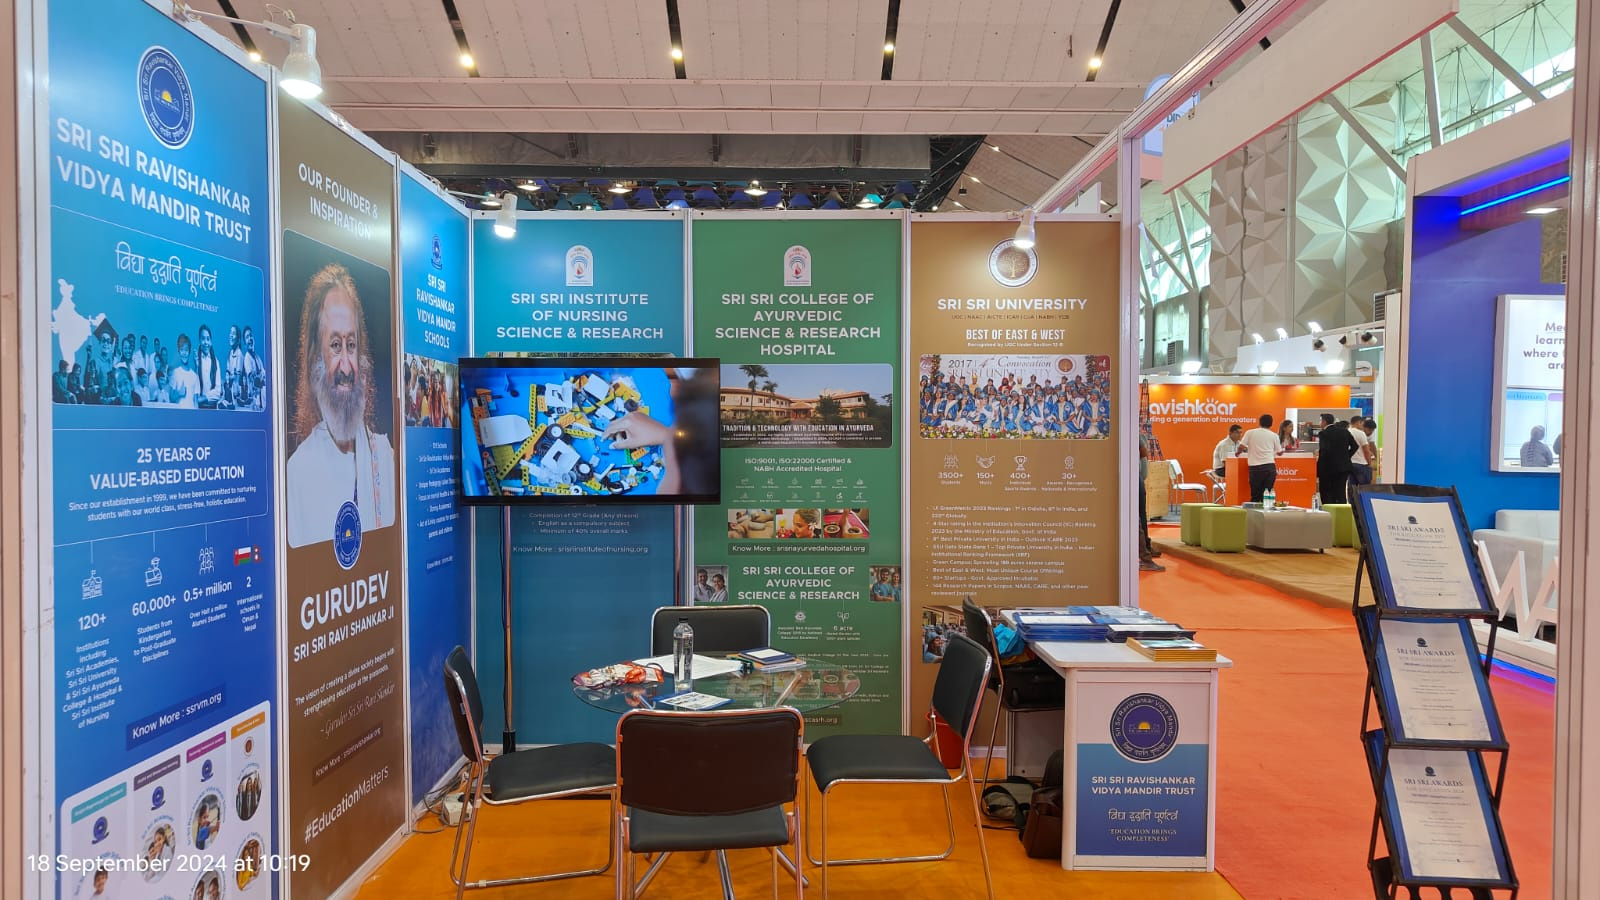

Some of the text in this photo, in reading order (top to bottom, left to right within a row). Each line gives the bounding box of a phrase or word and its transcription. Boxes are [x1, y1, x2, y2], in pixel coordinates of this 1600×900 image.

[57, 117, 250, 215] SRI SRI RAVISHANKAR
[299, 163, 378, 219] OUR FOUNDER &
[56, 155, 251, 244] VIDYA MANDIR TRUST
[310, 197, 371, 239] INSPIRATION
[428, 274, 446, 292] SRI SRI
[155, 293, 177, 305] BRINGS
[417, 288, 455, 314] RAVISHANKAR
[511, 293, 648, 304] SRI SRI INSTITUTE
[722, 293, 874, 304] SRI SRI COLLEGE OF
[938, 299, 1087, 310] SRI SRI UNIVERSITY
[417, 308, 456, 332] VIDYA MANDIR
[532, 311, 628, 321] OF NURSING
[754, 310, 842, 322] AYURVEDIC
[424, 330, 449, 349] SCHOOLS
[497, 327, 663, 338] SCIENCE & RESEARCH
[715, 327, 881, 339] SCIENCE & RESEARCH
[966, 329, 1065, 340] BEST OF EAST & WEST
[1536, 335, 1565, 344] learn
[760, 344, 835, 356] HOSPITAL
[1523, 349, 1558, 358] where
[949, 360, 972, 368] 2017
[137, 447, 211, 464] 25 YEARS OF
[90, 465, 245, 490] VALUE-BASED EDUCATION
[69, 502, 88, 511] Since
[90, 501, 100, 509] our
[102, 497, 145, 507] establishment
[192, 490, 204, 498] been
[206, 488, 230, 497] committed
[88, 511, 116, 521] students
[118, 509, 131, 518] with
[144, 506, 160, 514] world
[743, 567, 855, 575] SRI SRI COLLEGE OF
[247, 576, 251, 588] 2
[766, 579, 831, 588] AYURVEDIC
[183, 581, 232, 602] 0.5+ million
[738, 592, 860, 600] SCIENCE & RESEARCH
[132, 595, 176, 616] 60,000+
[301, 570, 388, 630] GURUDEV
[78, 613, 107, 631] 120+
[294, 605, 394, 662] SRI SRI RAVI SHANKAR JI
[132, 692, 222, 739] Know More ssrvm.org
[305, 766, 389, 844] #EducationMatters
